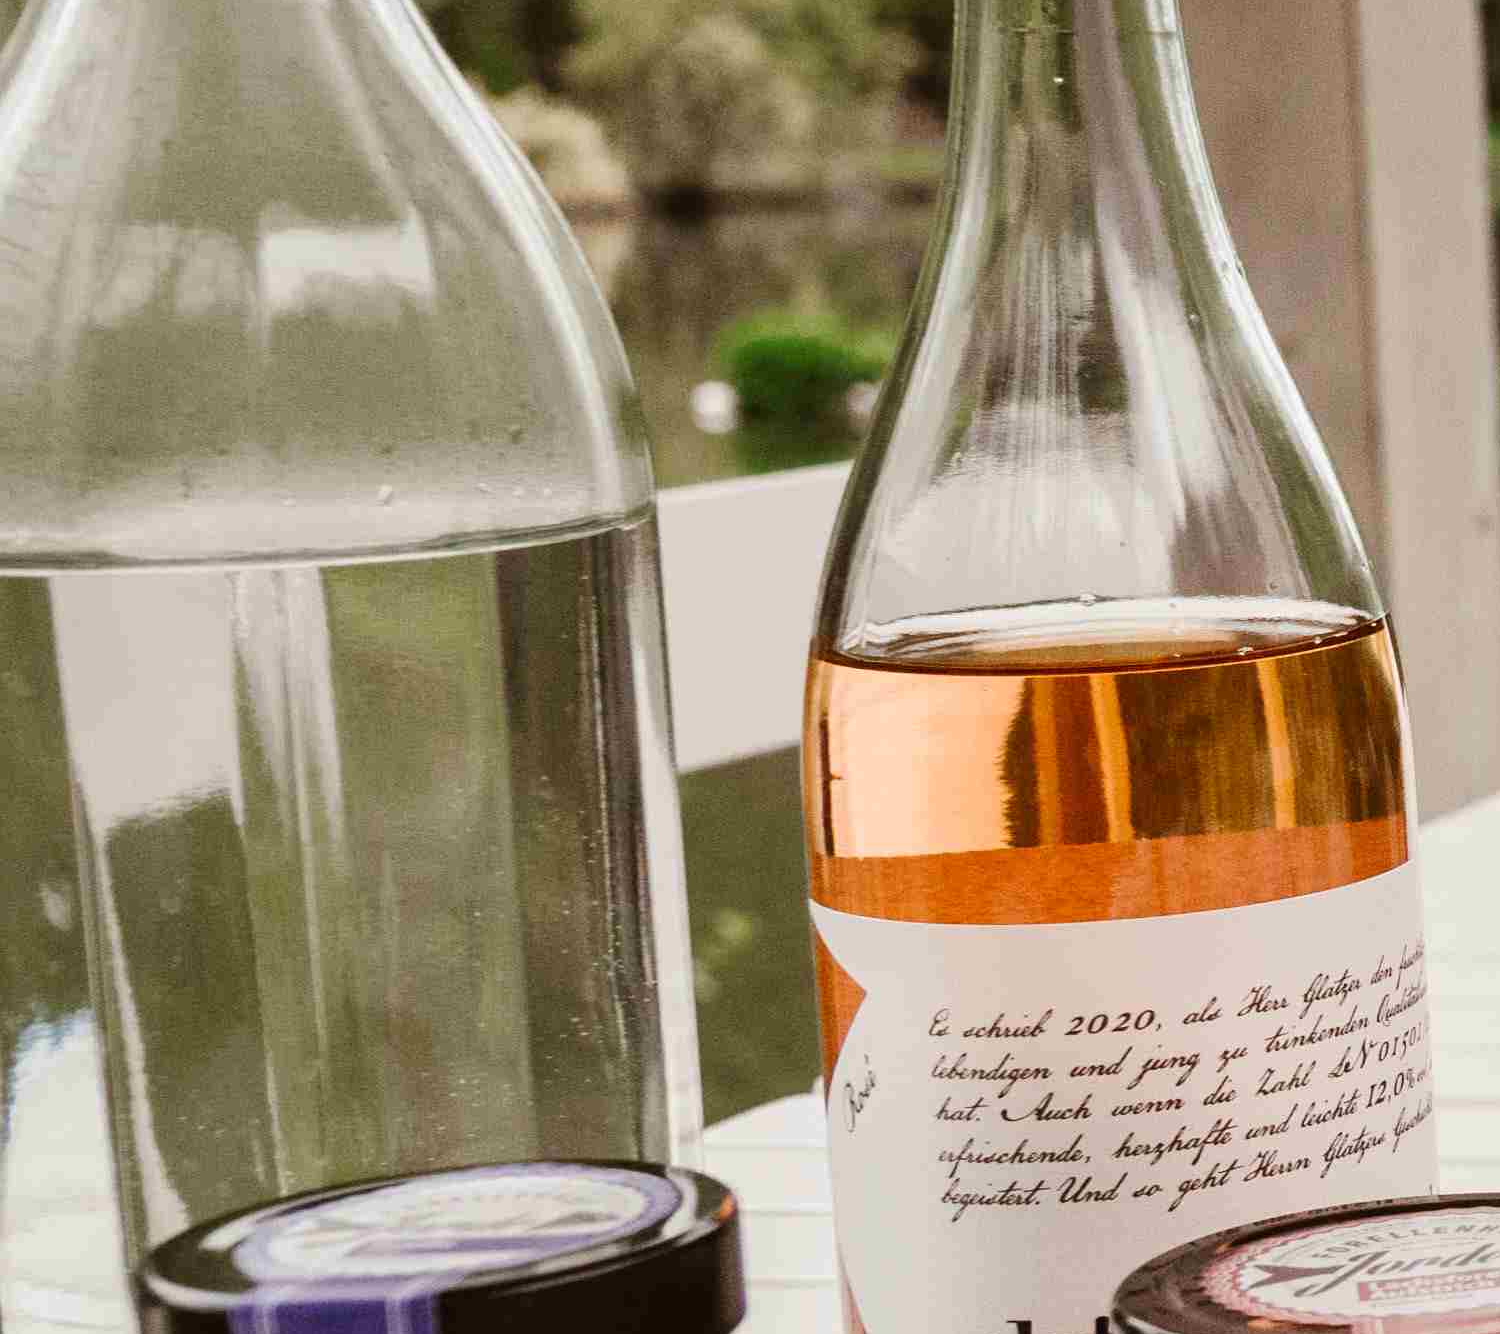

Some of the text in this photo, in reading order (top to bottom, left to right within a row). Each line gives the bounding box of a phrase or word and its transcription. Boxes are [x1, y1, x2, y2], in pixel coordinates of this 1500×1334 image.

[929, 1008, 950, 1037] Es
[963, 1009, 1053, 1038] schrieb
[1065, 1009, 1161, 1036] 2020,
[1183, 995, 1221, 1025] als
[1237, 985, 1290, 1017] Herr
[1299, 969, 1361, 1019] Glatzer
[931, 1052, 1051, 1098] lebendigen
[1070, 1046, 1132, 1077] und
[1127, 1044, 1200, 1089] jung
[1217, 1047, 1247, 1073] zu
[1264, 1006, 1368, 1053] trinkenden
[935, 1097, 990, 1122] hat.
[1001, 1092, 1092, 1122] Auch
[1112, 1098, 1185, 1117] wenn
[1203, 1075, 1235, 1107] die
[1255, 1061, 1316, 1096] Zahl
[938, 1134, 1092, 1179] erfrischende,
[1112, 1117, 1239, 1166] herzhafte
[1245, 1103, 1298, 1141] und
[1301, 1088, 1361, 1129] leichte
[941, 1177, 1050, 1223] begeistert.
[1057, 1172, 1128, 1204] Und
[1132, 1181, 1163, 1198] so
[1168, 1159, 1242, 1212] geht
[1243, 1149, 1312, 1182] Herrn
